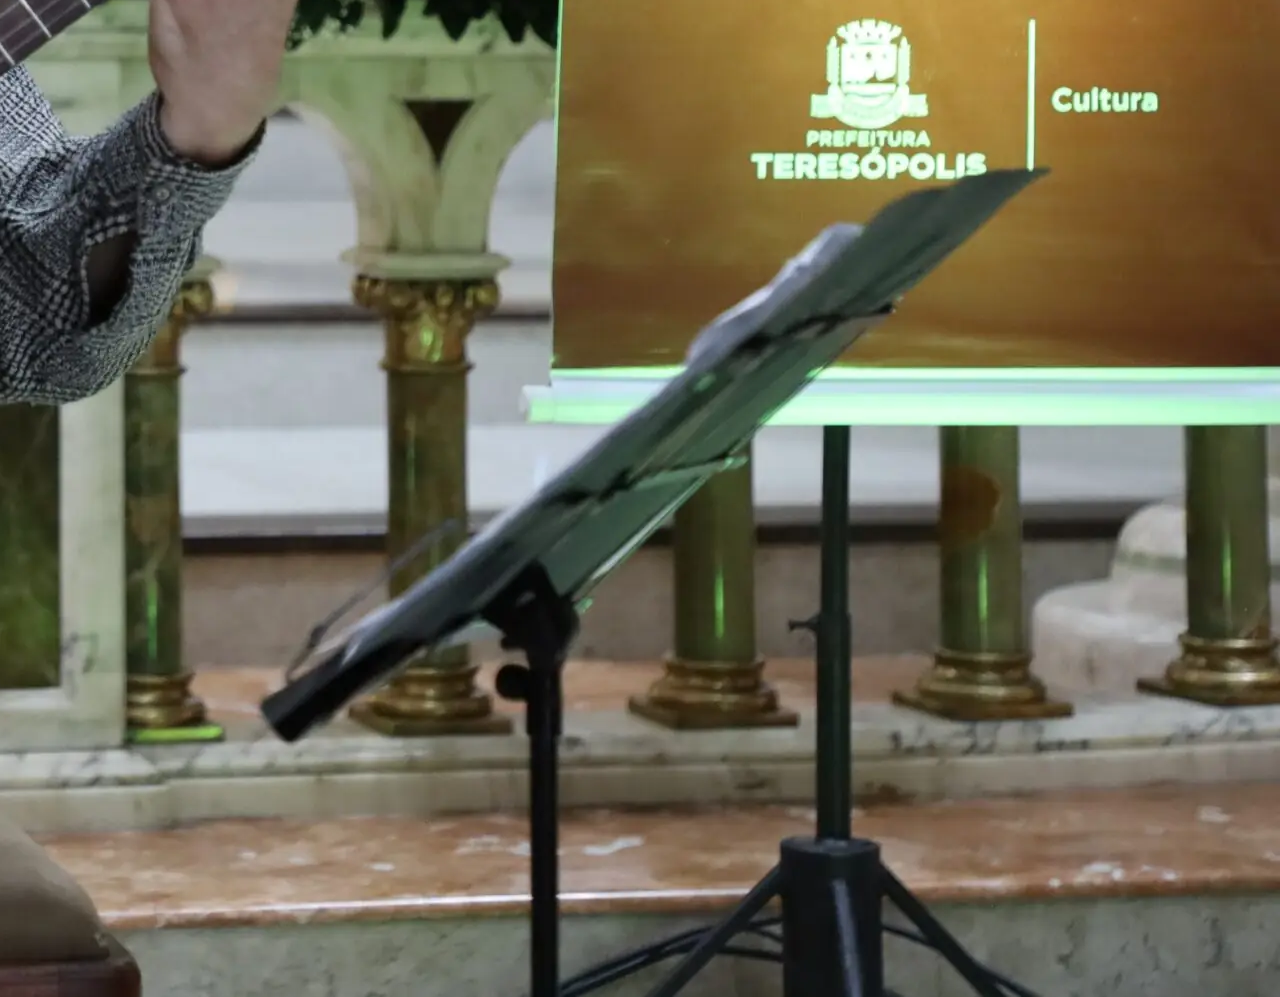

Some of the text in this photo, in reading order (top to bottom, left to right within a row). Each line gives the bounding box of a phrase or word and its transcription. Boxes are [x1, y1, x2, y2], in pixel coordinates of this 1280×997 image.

[1051, 86, 1159, 113] Cultura
[806, 129, 931, 148] PREFEITURA
[751, 146, 987, 180] TERESÓPOLIS
